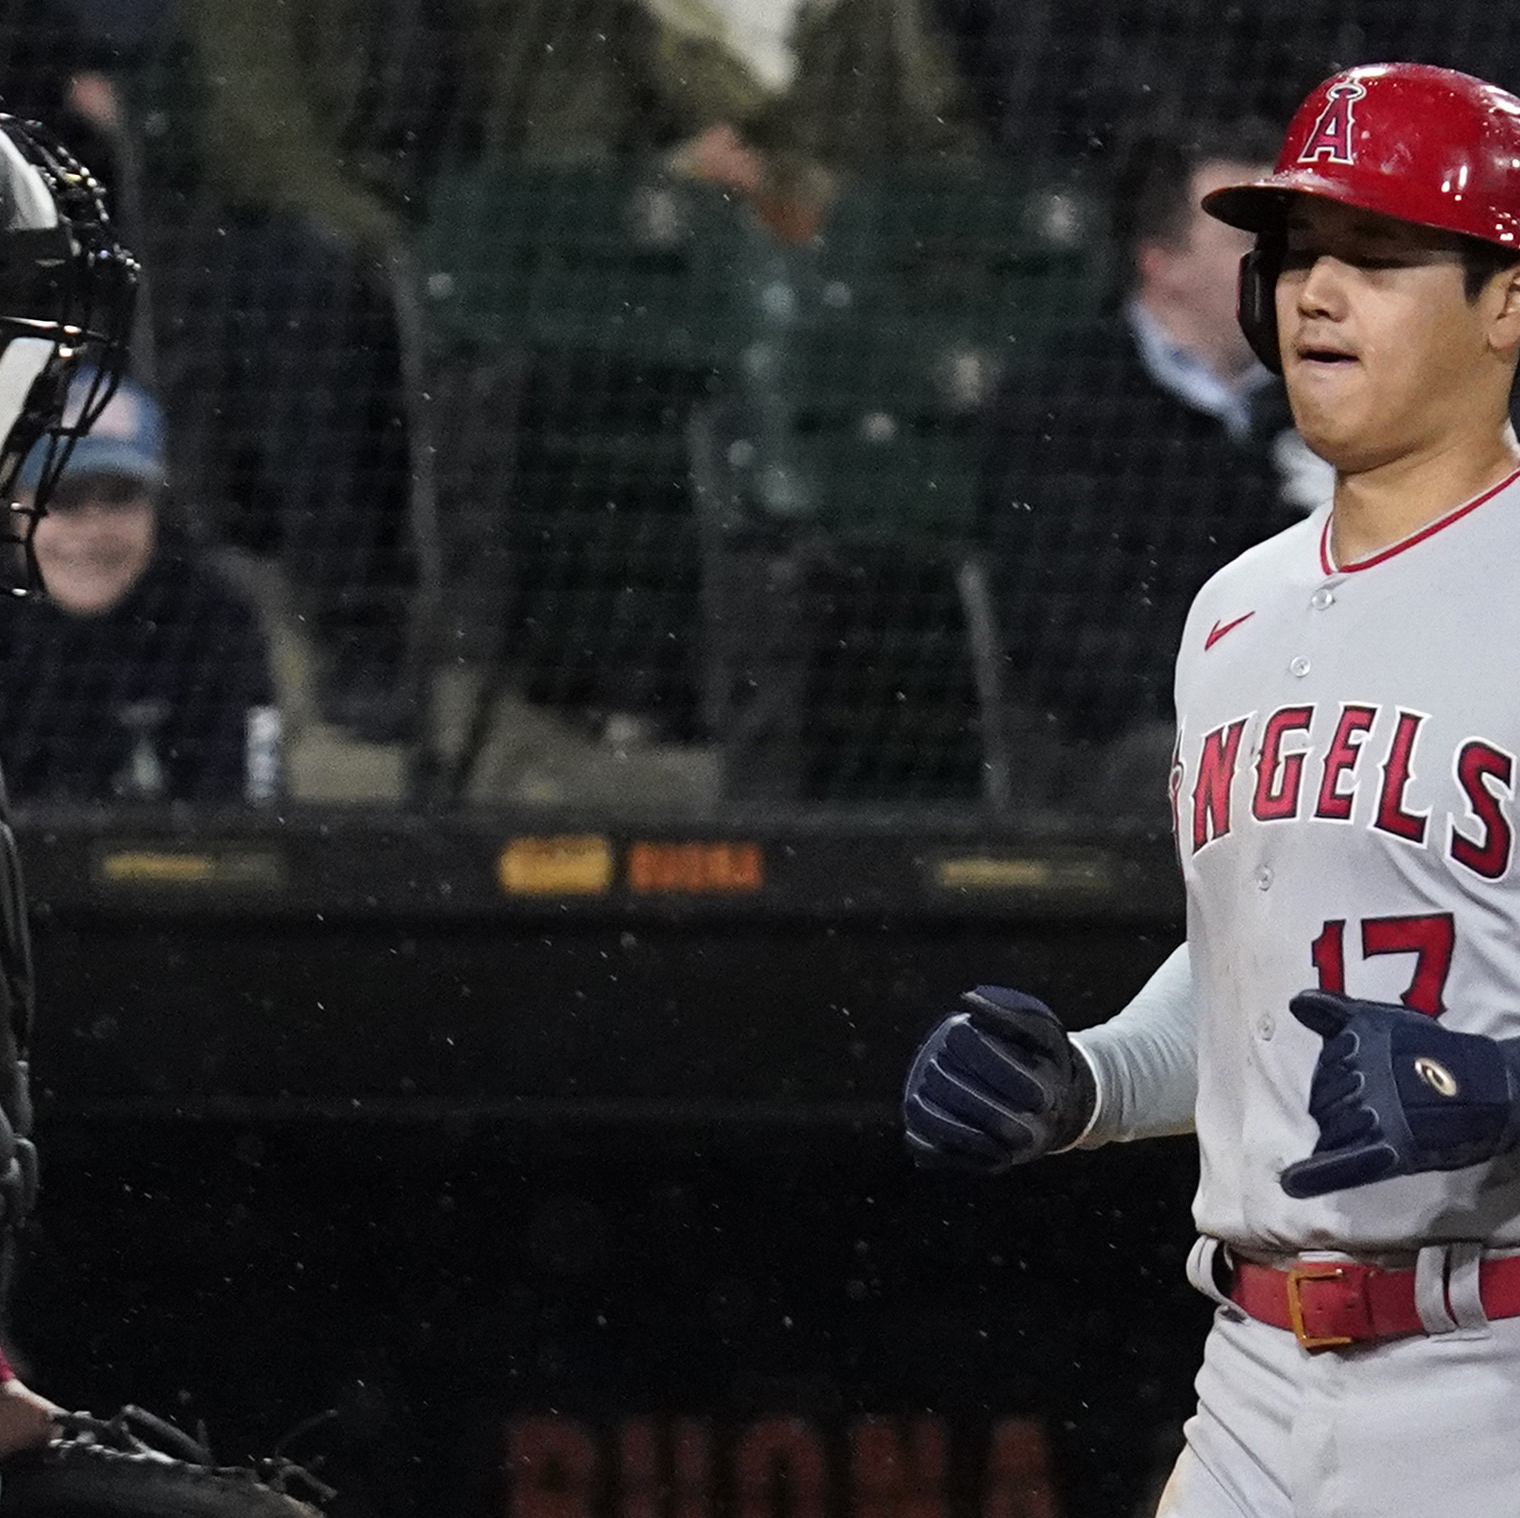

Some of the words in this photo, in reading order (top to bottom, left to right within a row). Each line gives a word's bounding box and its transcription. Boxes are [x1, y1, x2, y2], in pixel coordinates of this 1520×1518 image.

[1297, 78, 1367, 165] A
[1169, 702, 1517, 883] NGELS
[1311, 911, 1455, 1022] 17
